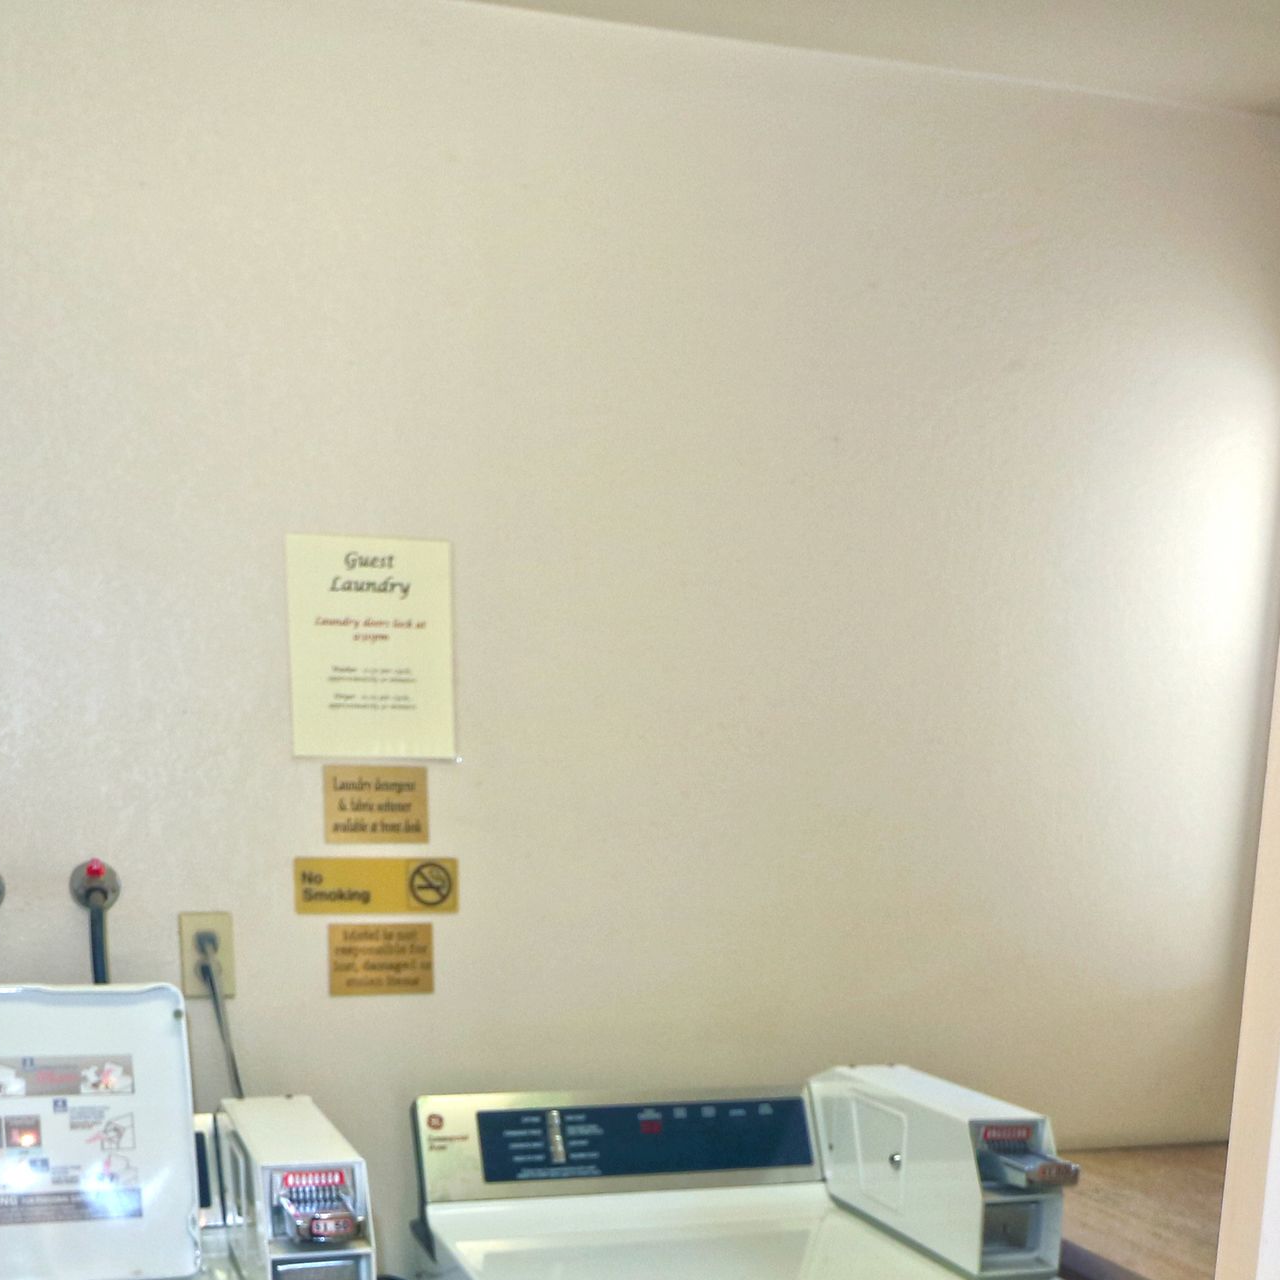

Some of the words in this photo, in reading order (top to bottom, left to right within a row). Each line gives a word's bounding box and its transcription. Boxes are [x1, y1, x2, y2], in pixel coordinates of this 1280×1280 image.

[344, 551, 394, 570] Guest
[330, 577, 410, 599] Laundry
[332, 775, 372, 793] Laundry
[301, 872, 323, 885] No
[303, 888, 371, 903] Smoking
